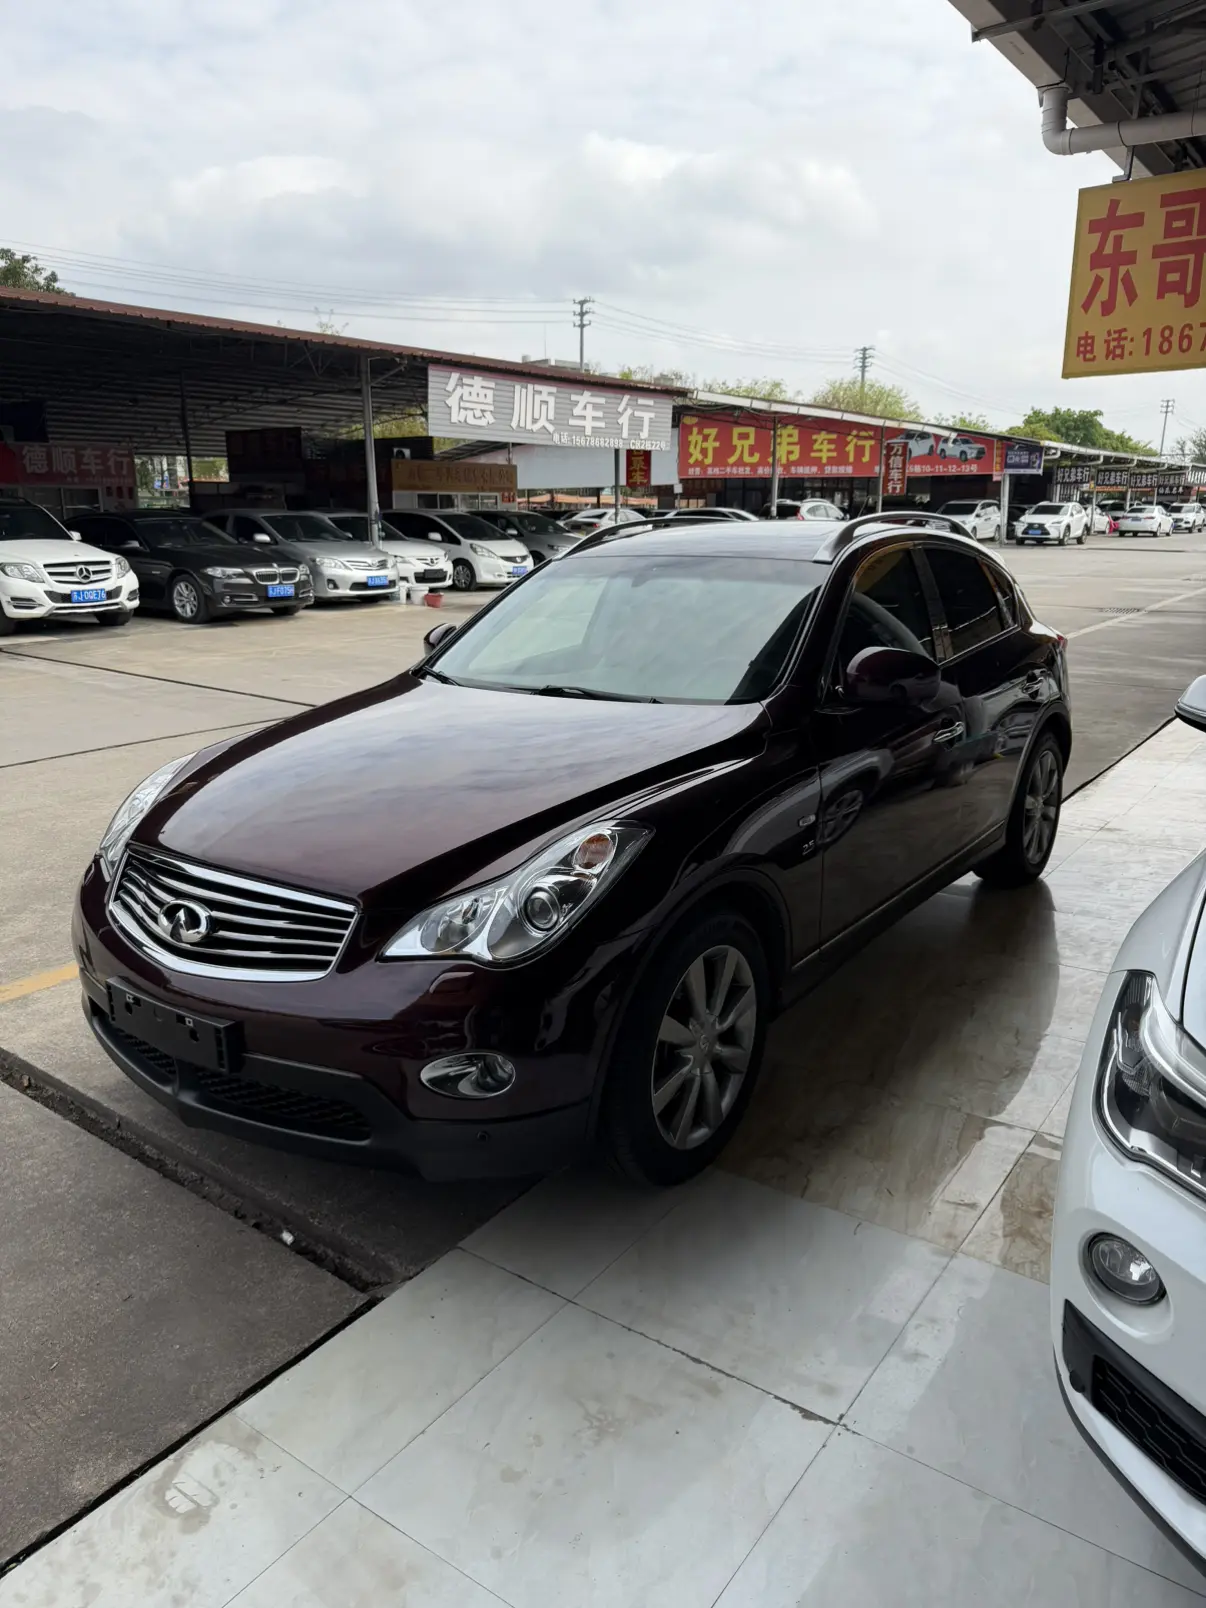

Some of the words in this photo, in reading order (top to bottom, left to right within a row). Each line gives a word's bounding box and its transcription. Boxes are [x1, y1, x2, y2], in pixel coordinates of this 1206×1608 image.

[1081, 188, 1206, 317] 东哥
[444, 372, 655, 440] 德顺车行
[22, 446, 130, 475] 德顺车行
[688, 424, 876, 465] 好兄弟车行
[887, 443, 905, 494] 万信车行
[1057, 467, 1090, 482] 好兄弟车行
[1098, 471, 1128, 485] 好兄弟车行
[1130, 473, 1158, 487] 好兄弟车行
